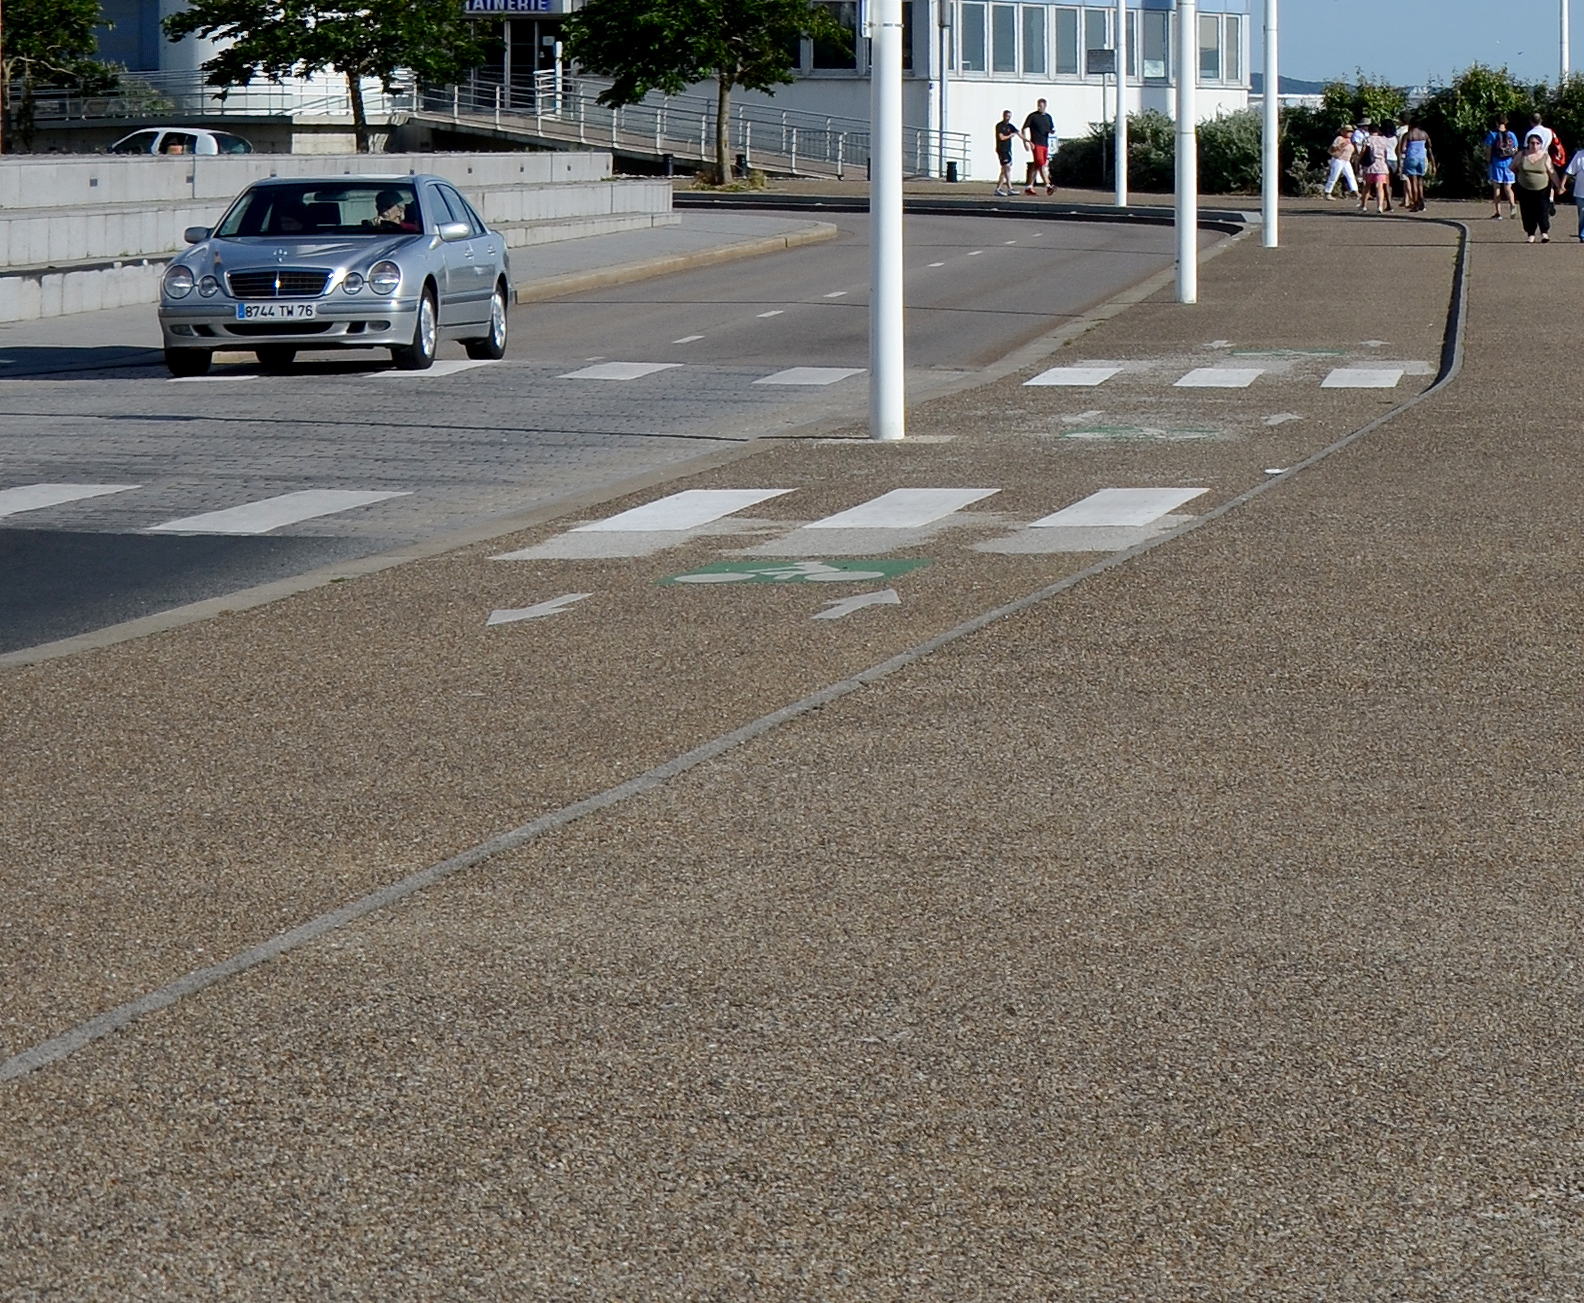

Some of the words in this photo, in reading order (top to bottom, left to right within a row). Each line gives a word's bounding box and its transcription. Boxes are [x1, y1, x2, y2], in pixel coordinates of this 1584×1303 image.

[245, 305, 275, 318] 8744
[279, 305, 294, 317] TW
[297, 305, 313, 316] 76
